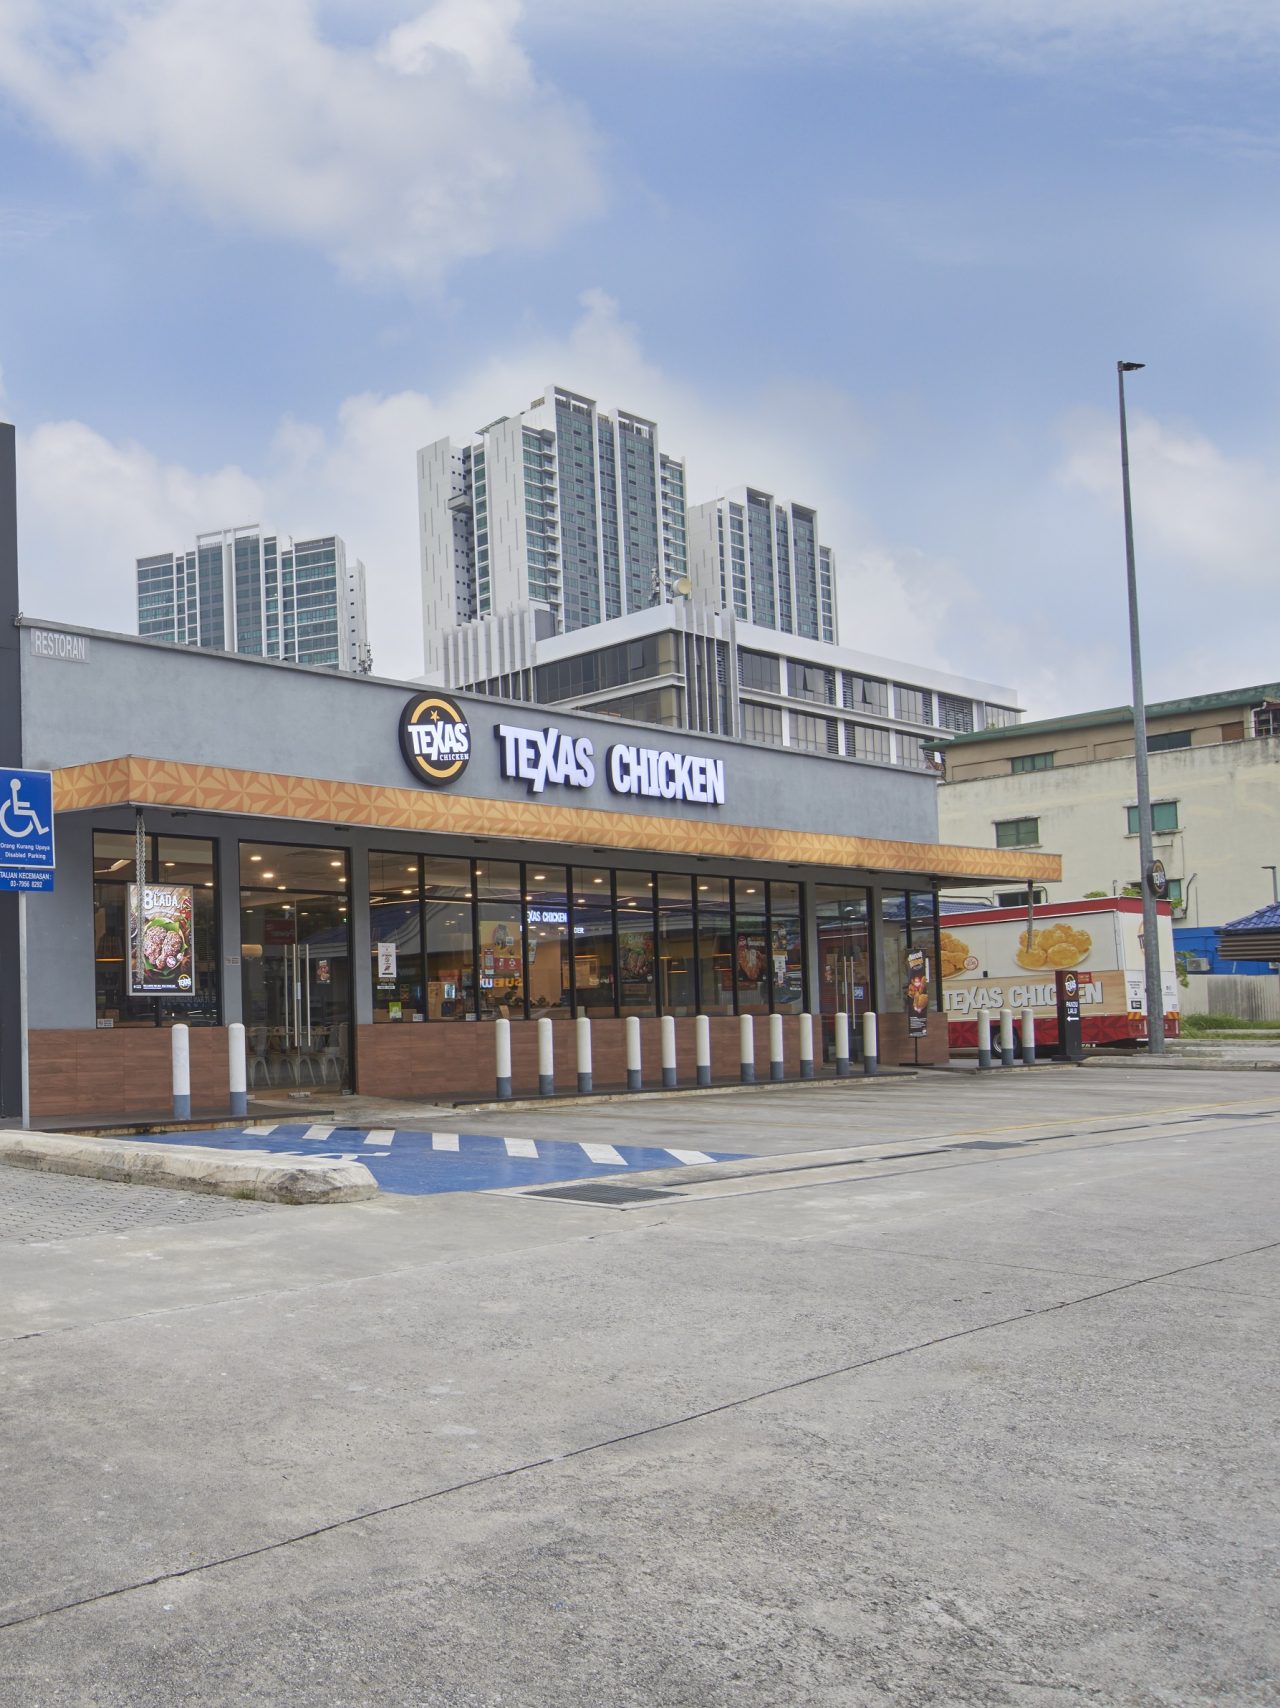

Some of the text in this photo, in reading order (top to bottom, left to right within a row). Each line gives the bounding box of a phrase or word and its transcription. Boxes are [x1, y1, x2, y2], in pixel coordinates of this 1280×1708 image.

[35, 631, 85, 660] RESTORAN
[407, 720, 469, 761] TEXAS
[439, 753, 469, 761] CHICKEN
[499, 724, 725, 805] TEXAS CHICKEN
[0, 842, 15, 850] Orang
[27, 852, 46, 860] Parking
[0, 871, 18, 879] TALIAN
[542, 911, 567, 923] CHICKEN
[942, 981, 1103, 1014] TEXAS CHICEN
